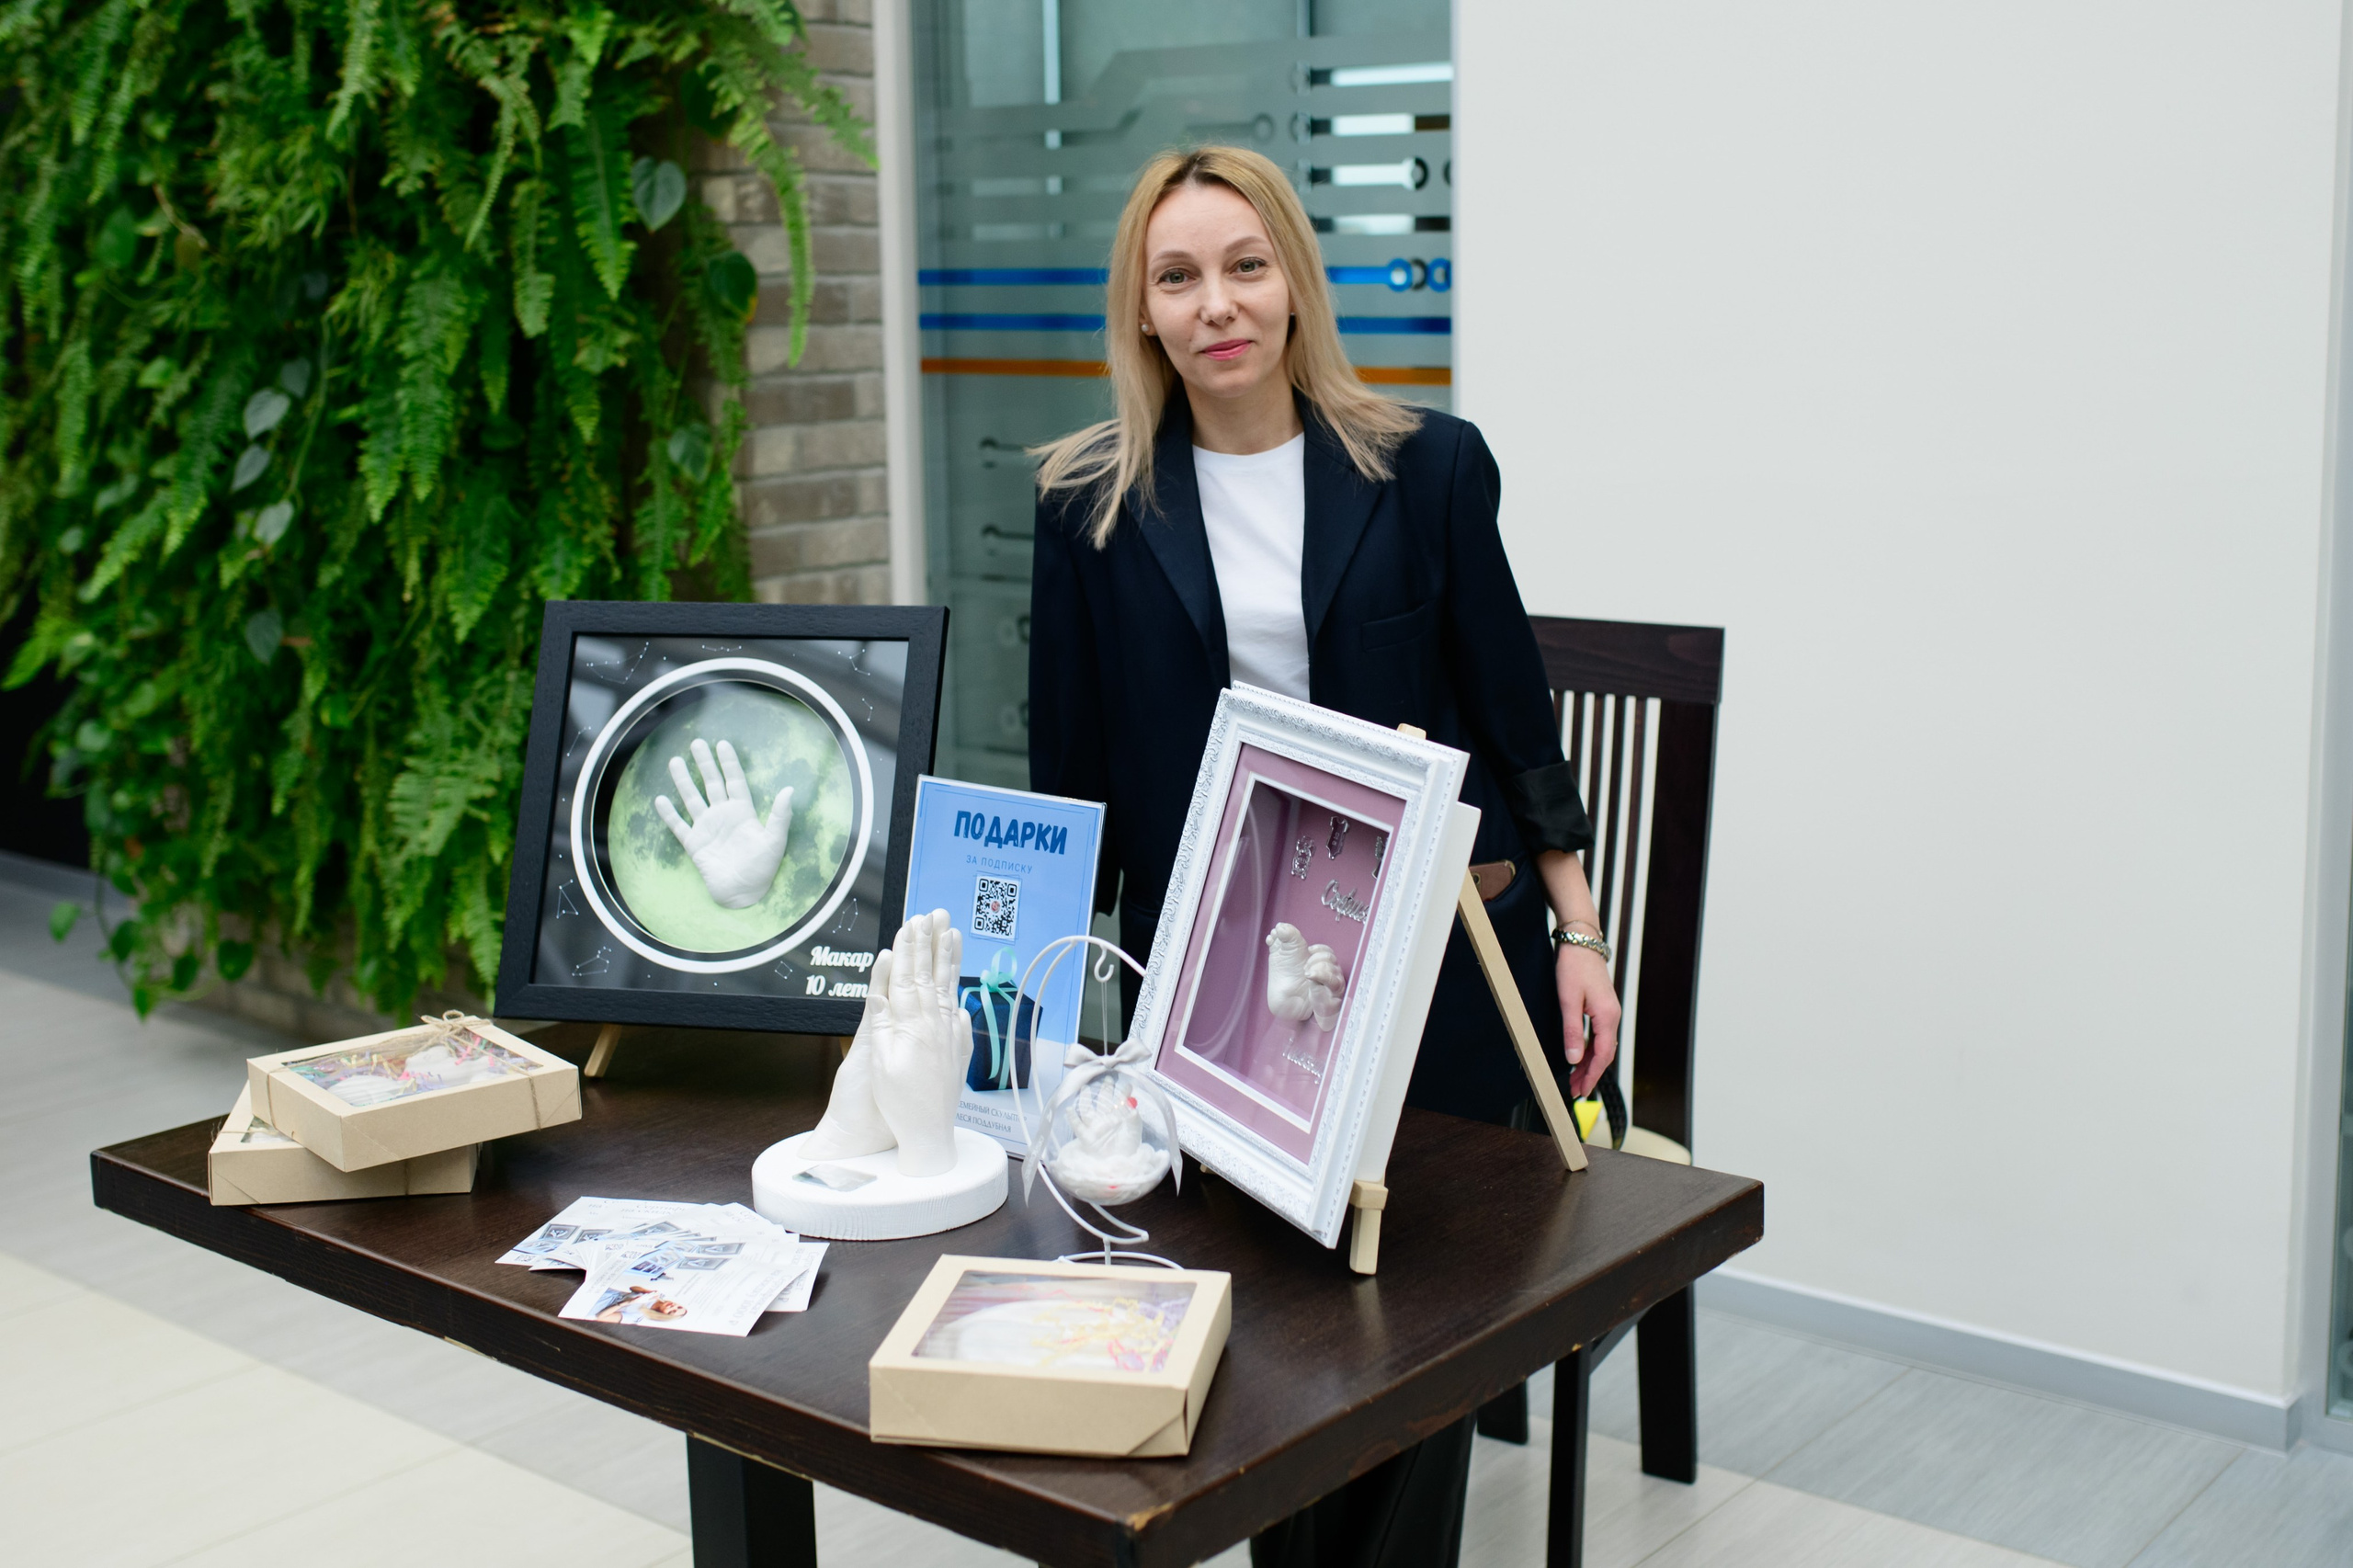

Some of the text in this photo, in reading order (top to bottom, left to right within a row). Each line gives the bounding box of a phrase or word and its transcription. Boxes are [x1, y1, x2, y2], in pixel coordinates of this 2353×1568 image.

[954, 810, 1068, 855] ПОДАРКИ
[966, 854, 1033, 874] ЗА ПОДПИСКУ
[810, 945, 875, 972] Макар
[805, 974, 870, 998] 10 лет
[958, 1100, 1028, 1122] ЕМЕЙНЫЙ СКУЛЬПТР
[972, 1116, 1012, 1133] ПОДДУБНАЯ
